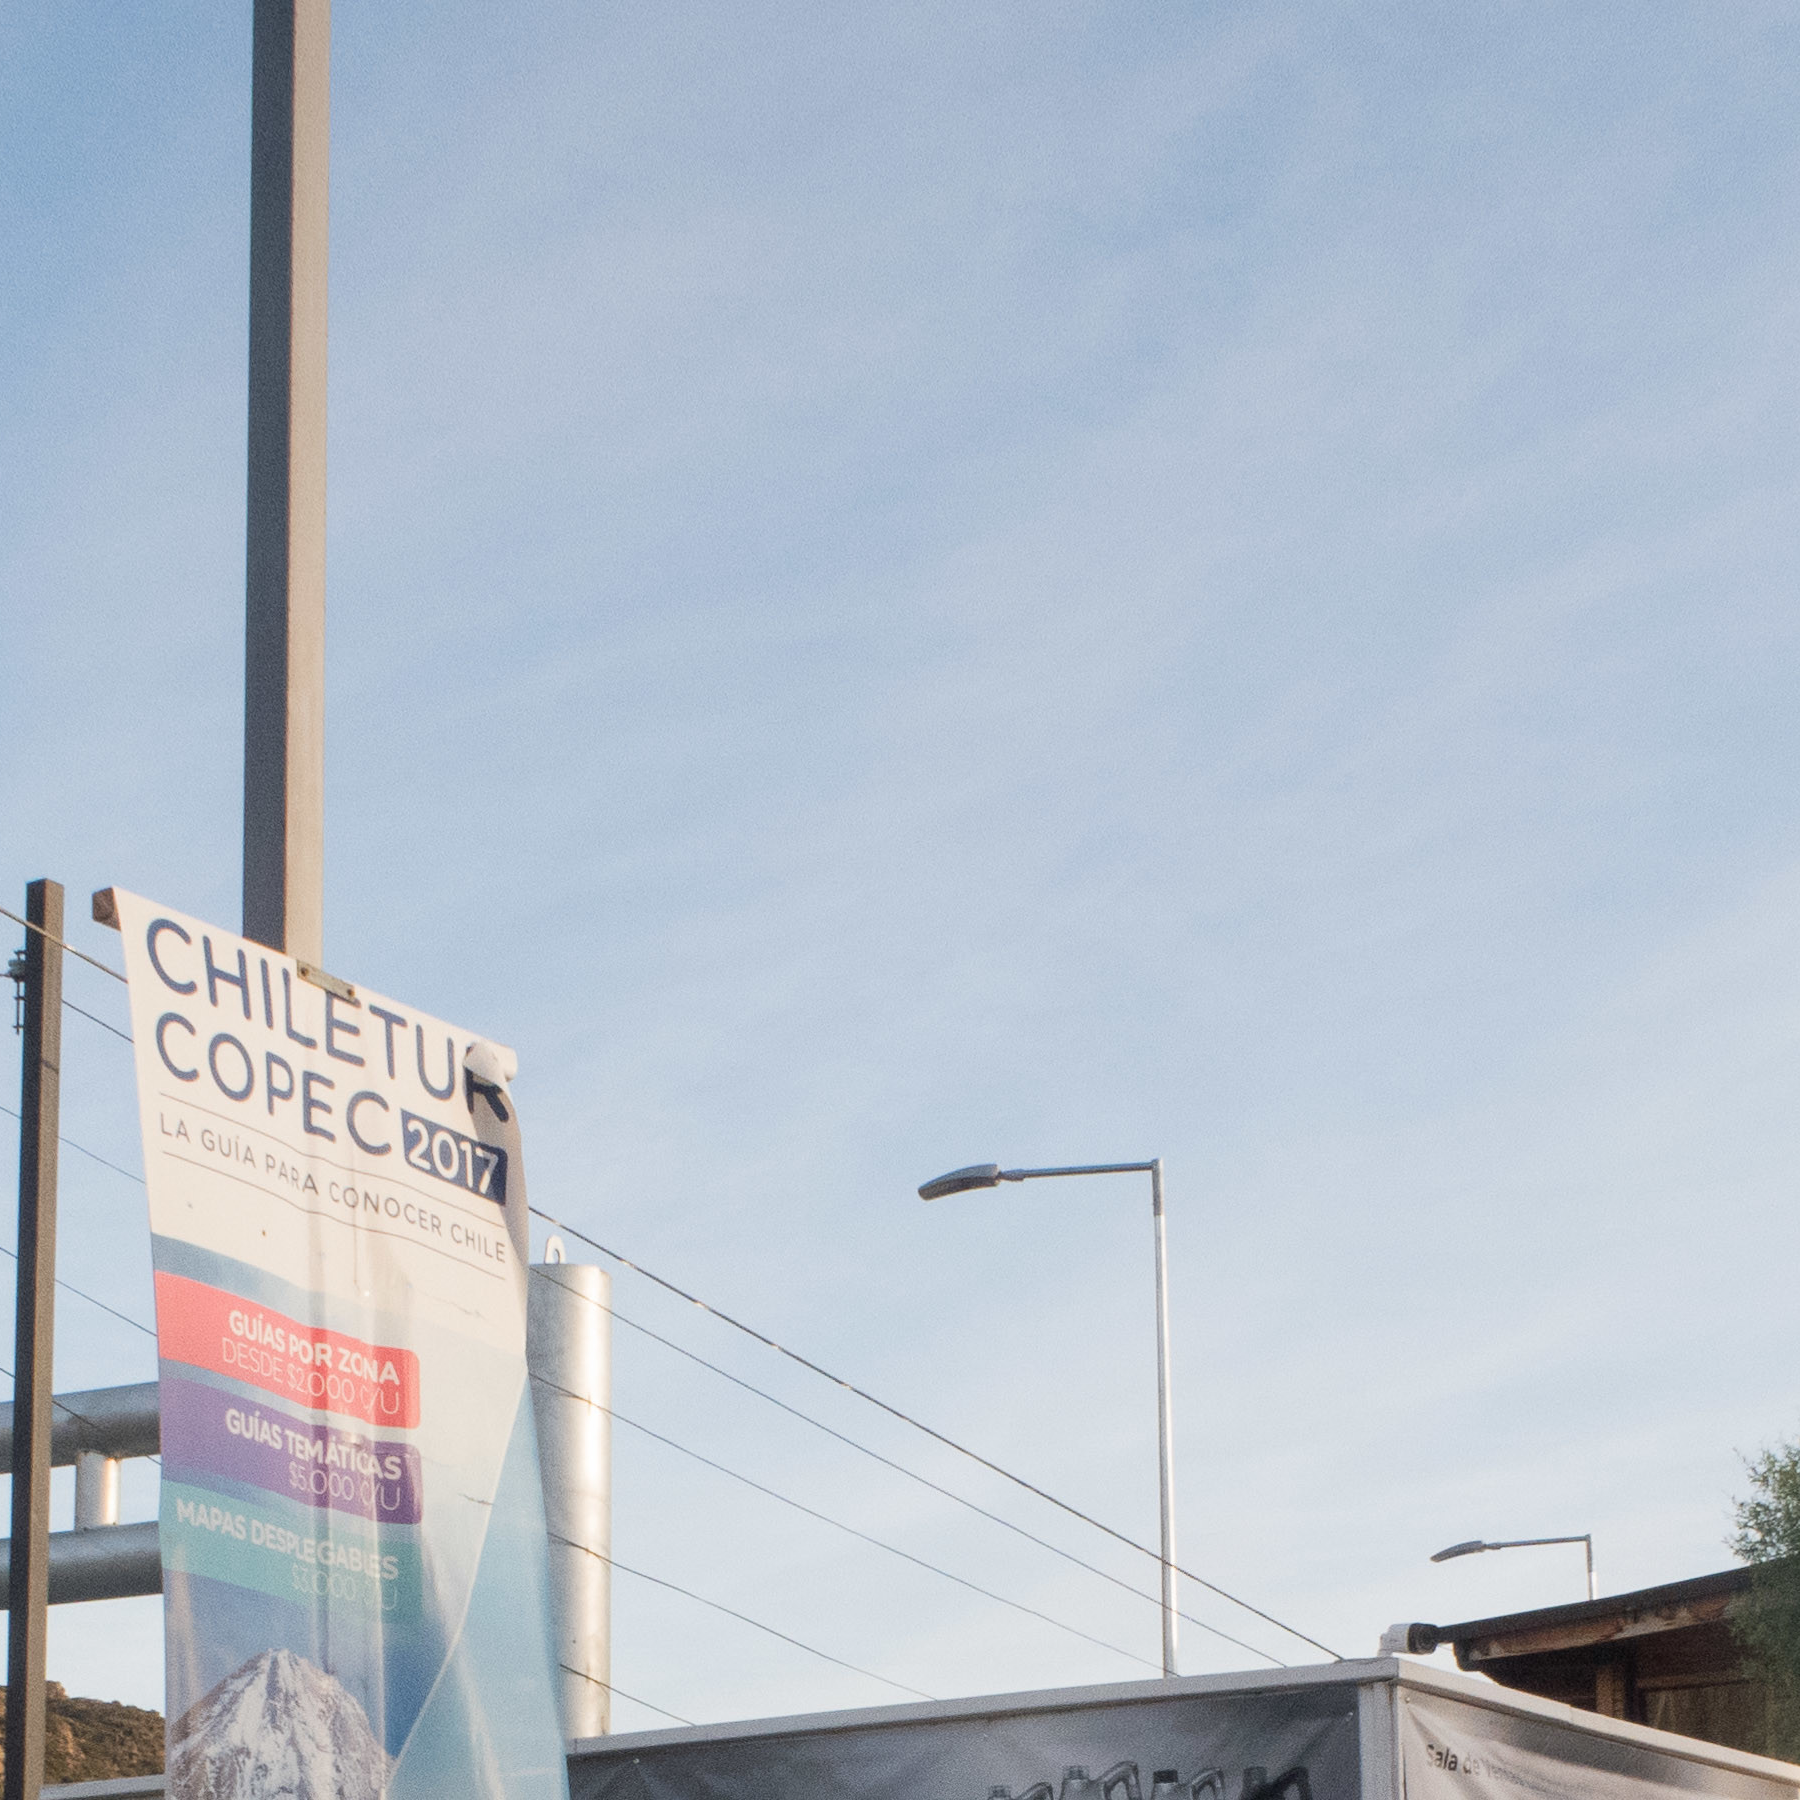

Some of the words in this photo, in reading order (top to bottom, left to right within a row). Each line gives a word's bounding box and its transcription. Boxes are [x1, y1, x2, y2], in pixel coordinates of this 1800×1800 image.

[155, 1012, 392, 1156] COPEC
[407, 1119, 498, 1195] 2017
[159, 1112, 191, 1143] LA
[201, 1129, 256, 1168] GUÍA
[265, 1154, 319, 1196] PARA
[329, 1182, 442, 1237] CONOCER
[451, 1223, 506, 1264] CHILE
[222, 1337, 284, 1384] DESDE
[229, 1310, 286, 1353] GUÍAS
[289, 1333, 333, 1368] POR
[338, 1347, 400, 1385] ZONA
[225, 1408, 283, 1450] GUÍAS
[285, 1430, 402, 1480] TEMÁTICAS
[176, 1498, 247, 1540] MAPAS
[251, 1519, 399, 1580] DESPLEGABLES
